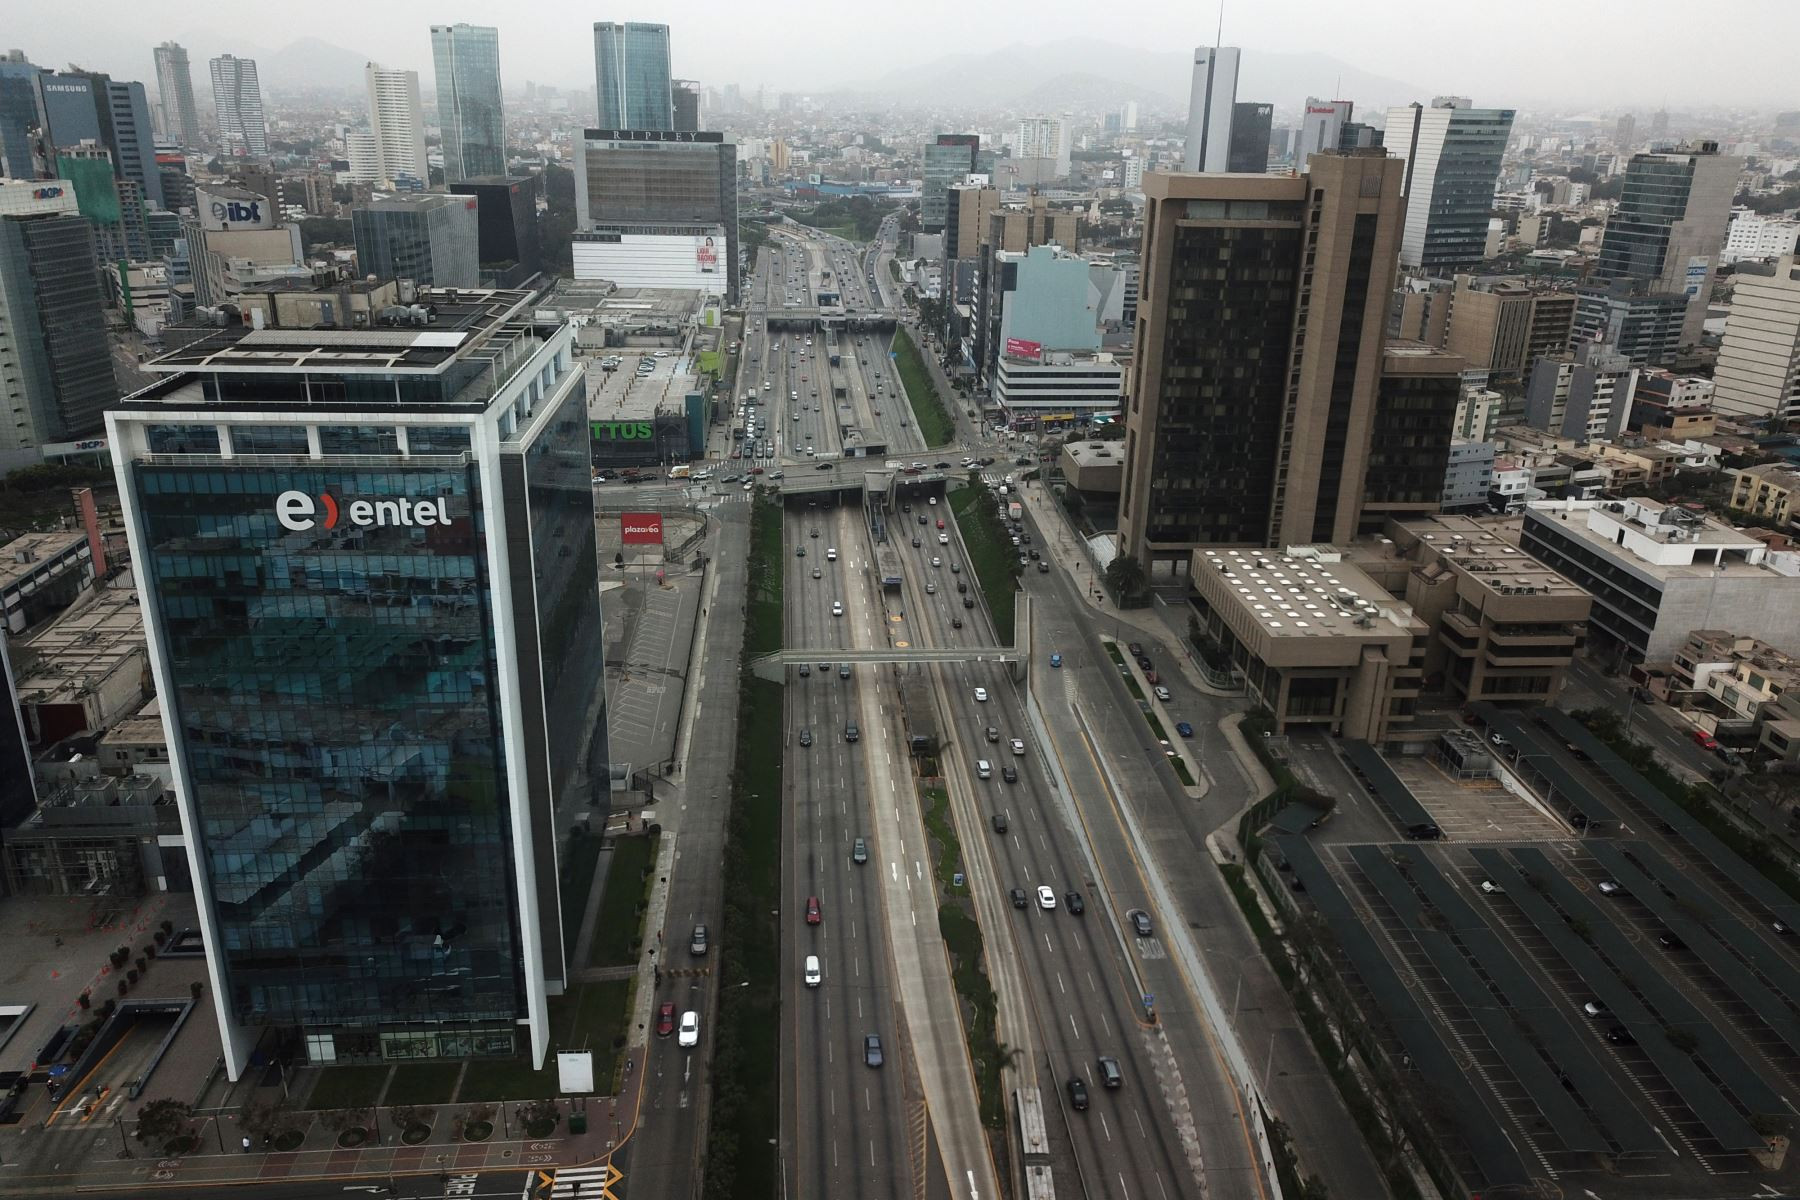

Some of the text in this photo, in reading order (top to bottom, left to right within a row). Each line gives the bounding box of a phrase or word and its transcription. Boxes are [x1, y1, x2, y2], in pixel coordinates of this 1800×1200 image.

[46, 84, 87, 93] SAMSUNG
[613, 130, 698, 142] RIPLEY
[227, 202, 261, 222] ibt
[81, 440, 100, 450] BCP
[349, 497, 453, 527] entel
[445, 1172, 479, 1195] PARE
